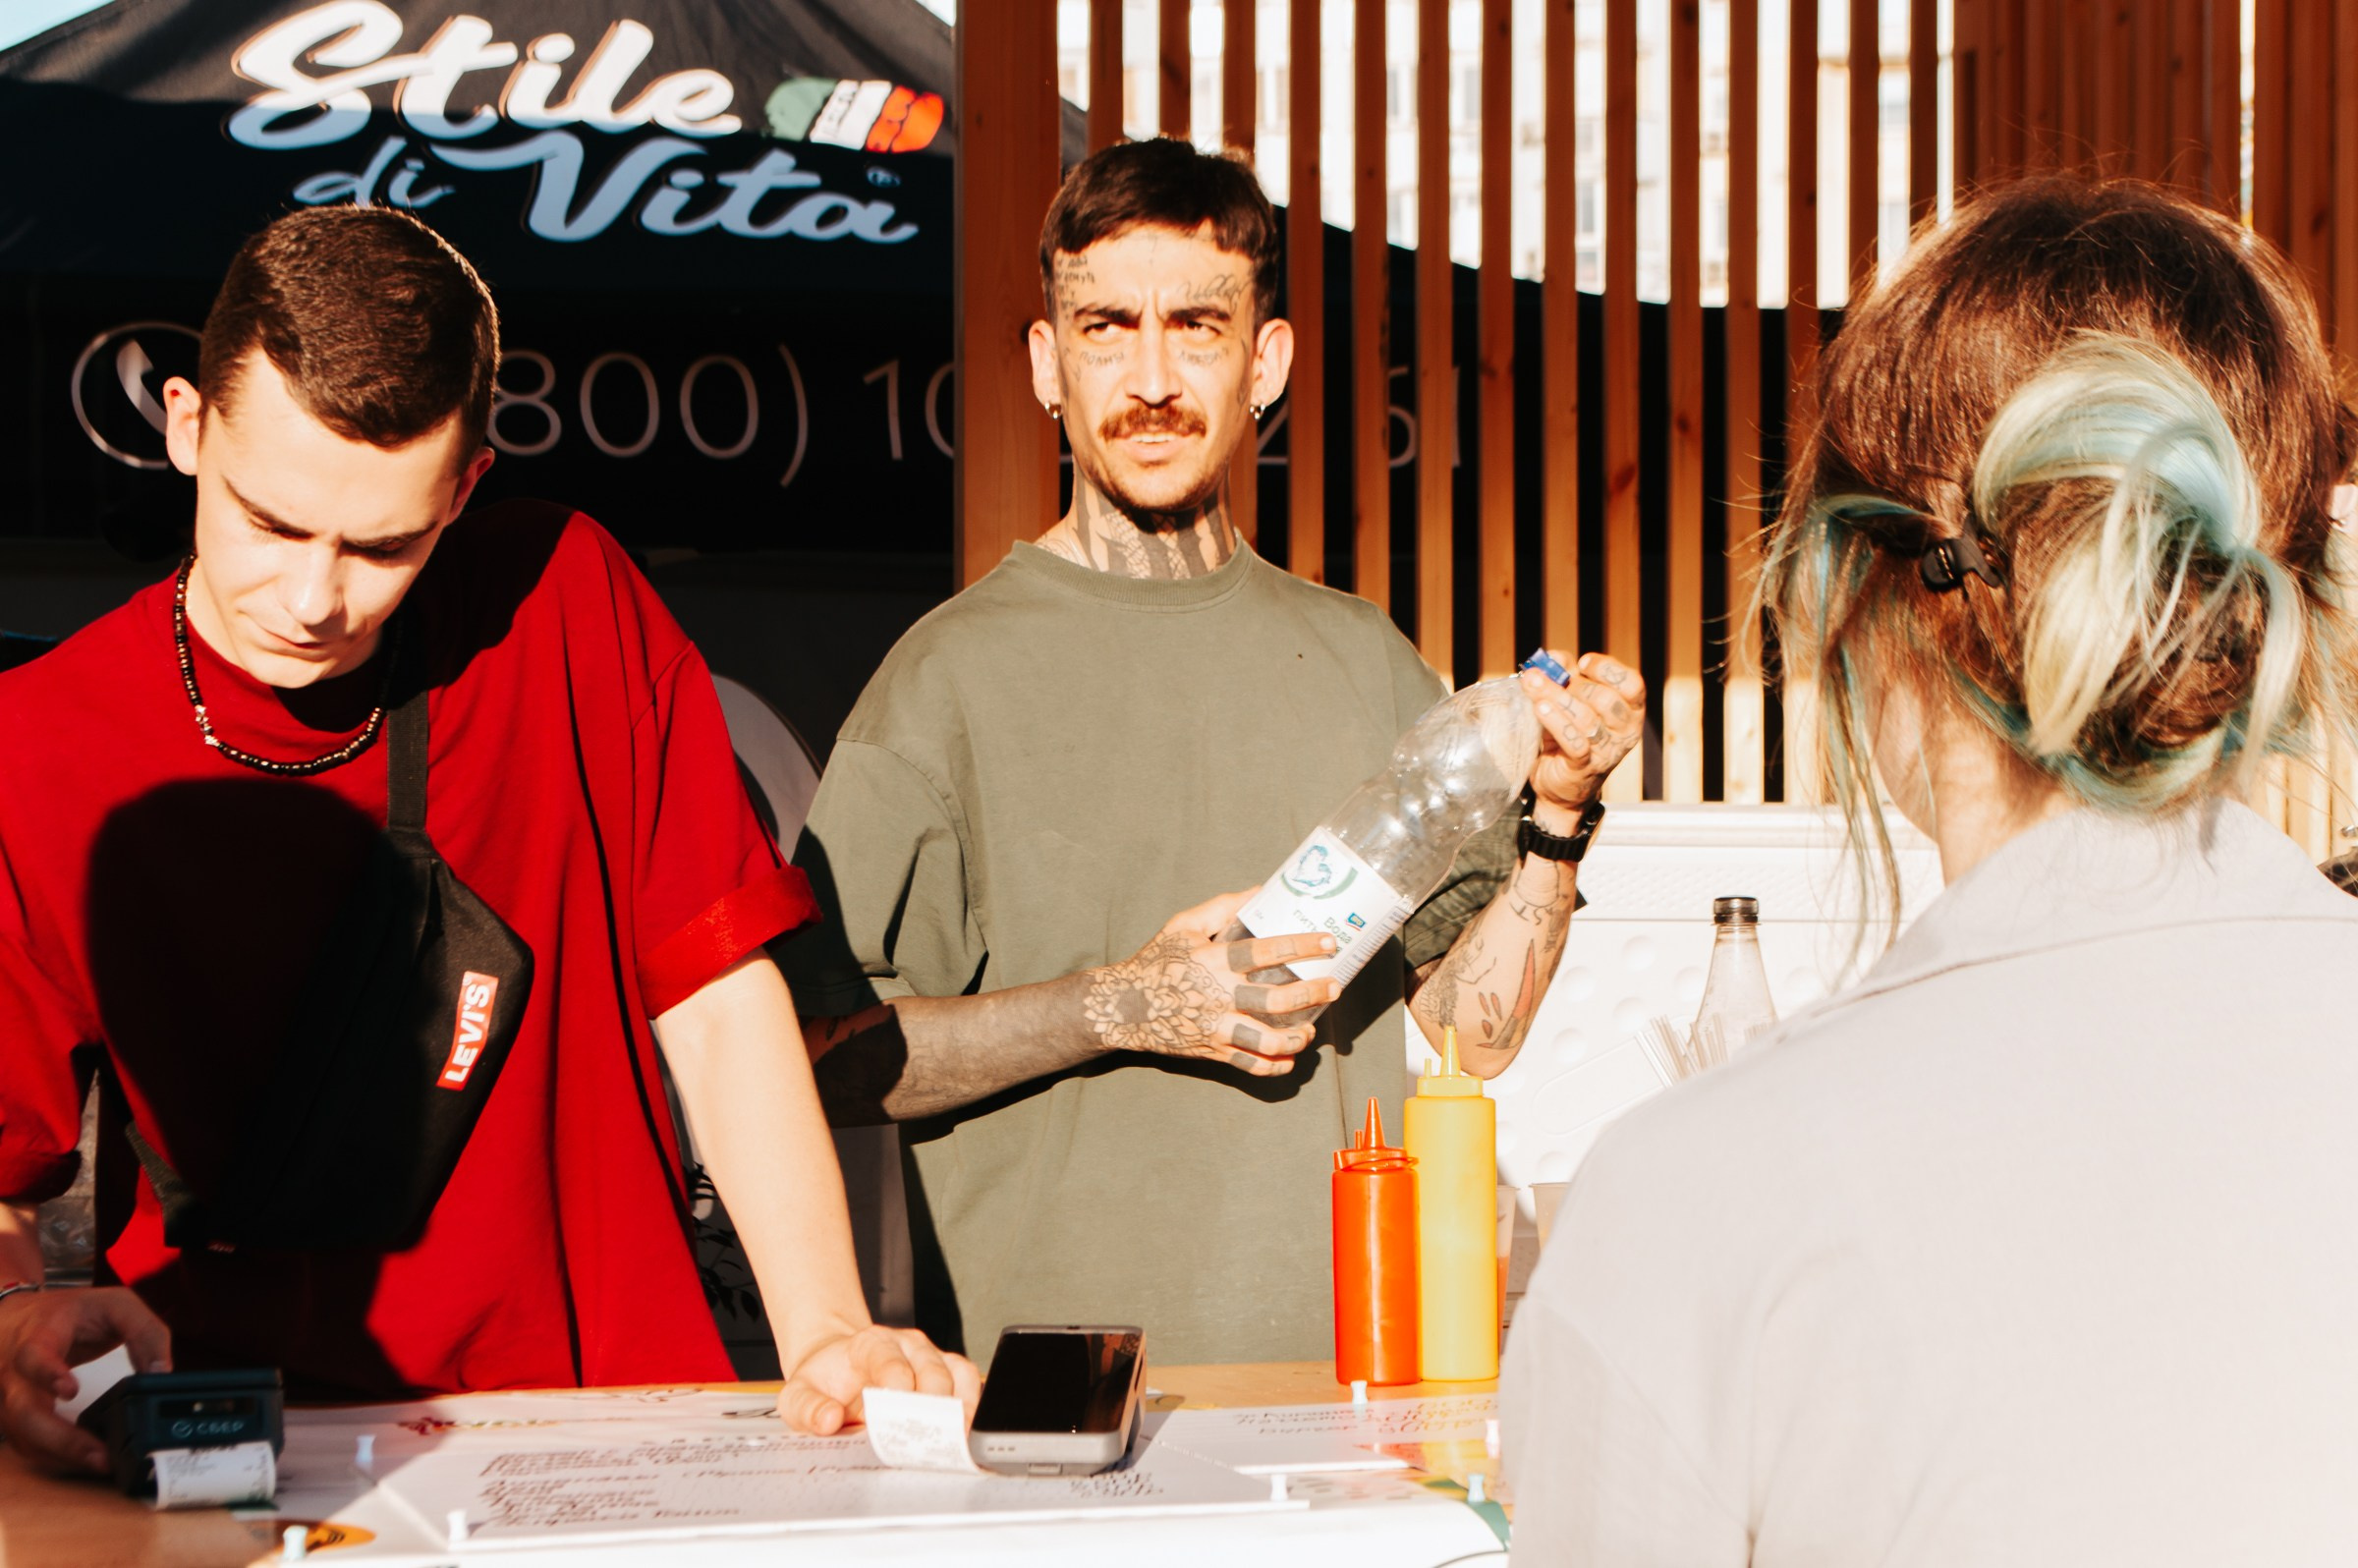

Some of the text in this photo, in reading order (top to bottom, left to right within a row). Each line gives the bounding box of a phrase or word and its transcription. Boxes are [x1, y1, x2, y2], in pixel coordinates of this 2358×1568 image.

[230, 0, 743, 148] Stile
[293, 129, 920, 243] di Vita
[1323, 916, 1354, 945] Вода
[445, 983, 490, 1083] LEVI'S
